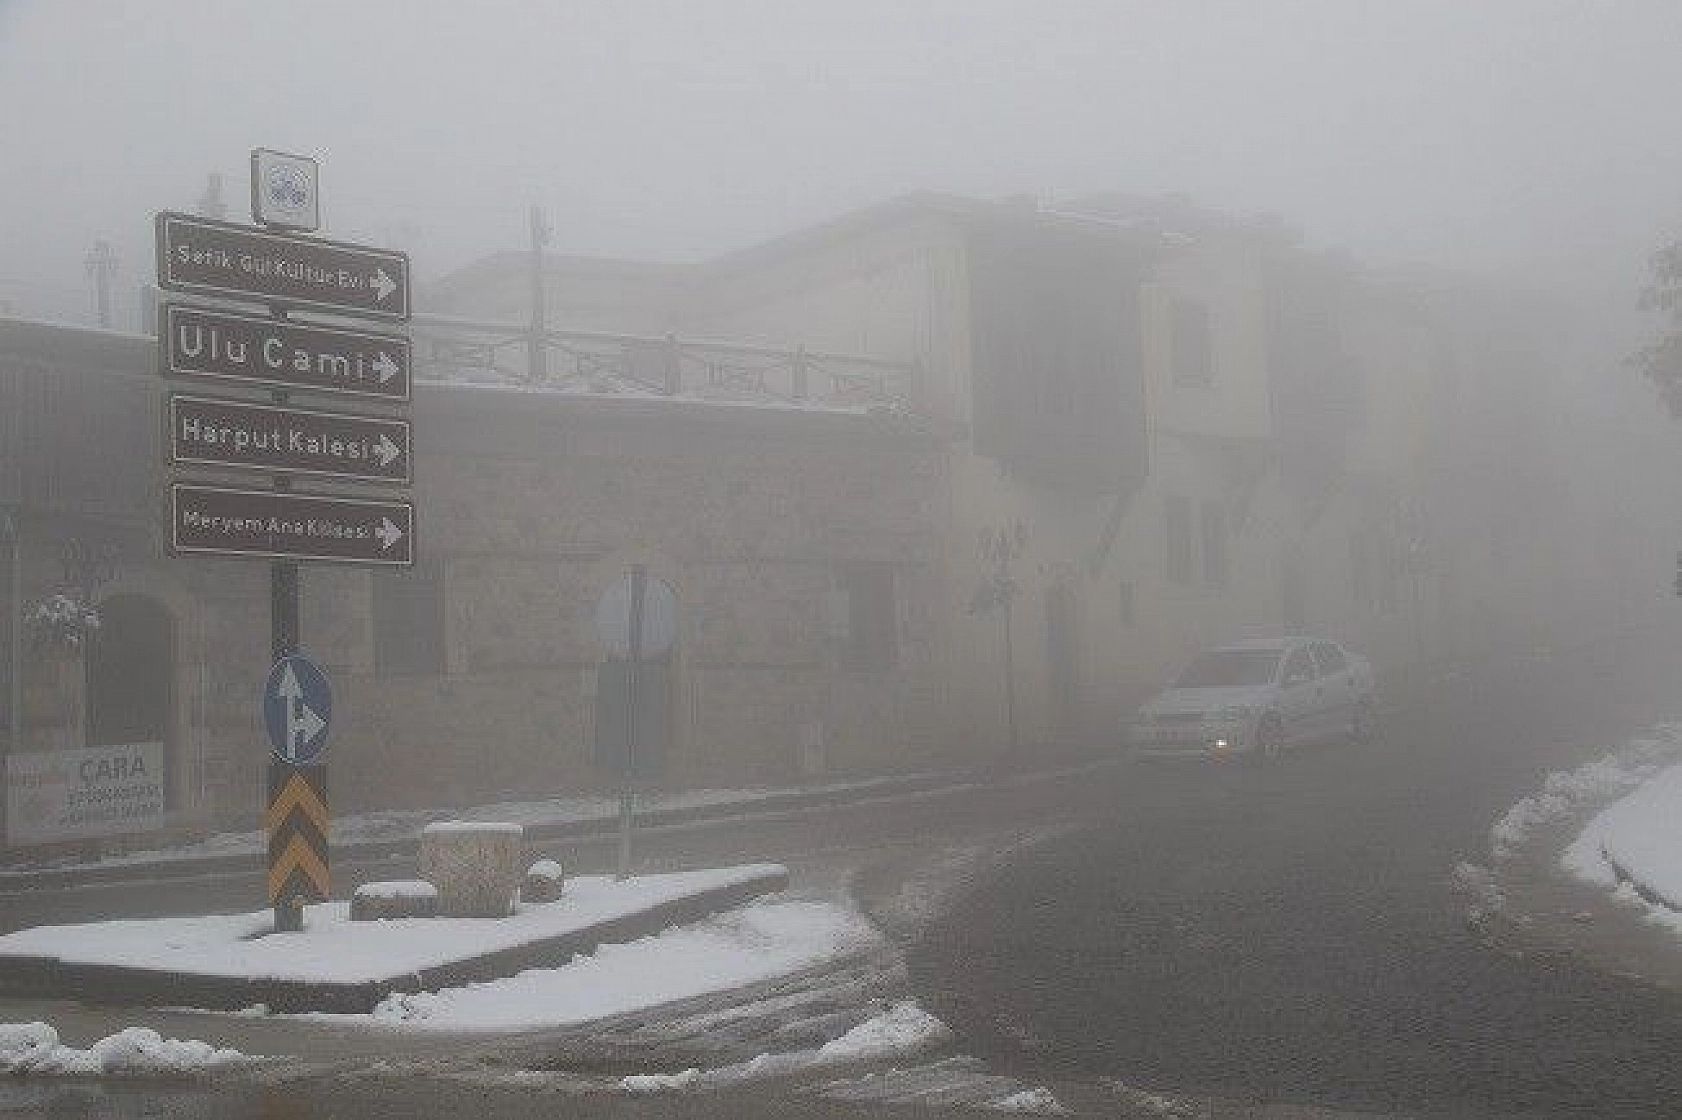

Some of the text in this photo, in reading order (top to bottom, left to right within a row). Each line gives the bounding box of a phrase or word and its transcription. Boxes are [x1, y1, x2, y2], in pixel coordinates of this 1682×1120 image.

[180, 325, 363, 379] Ulu Cami
[183, 418, 368, 459] Harput Kalesi
[183, 511, 265, 534] Meryem
[267, 516, 303, 534] Ana
